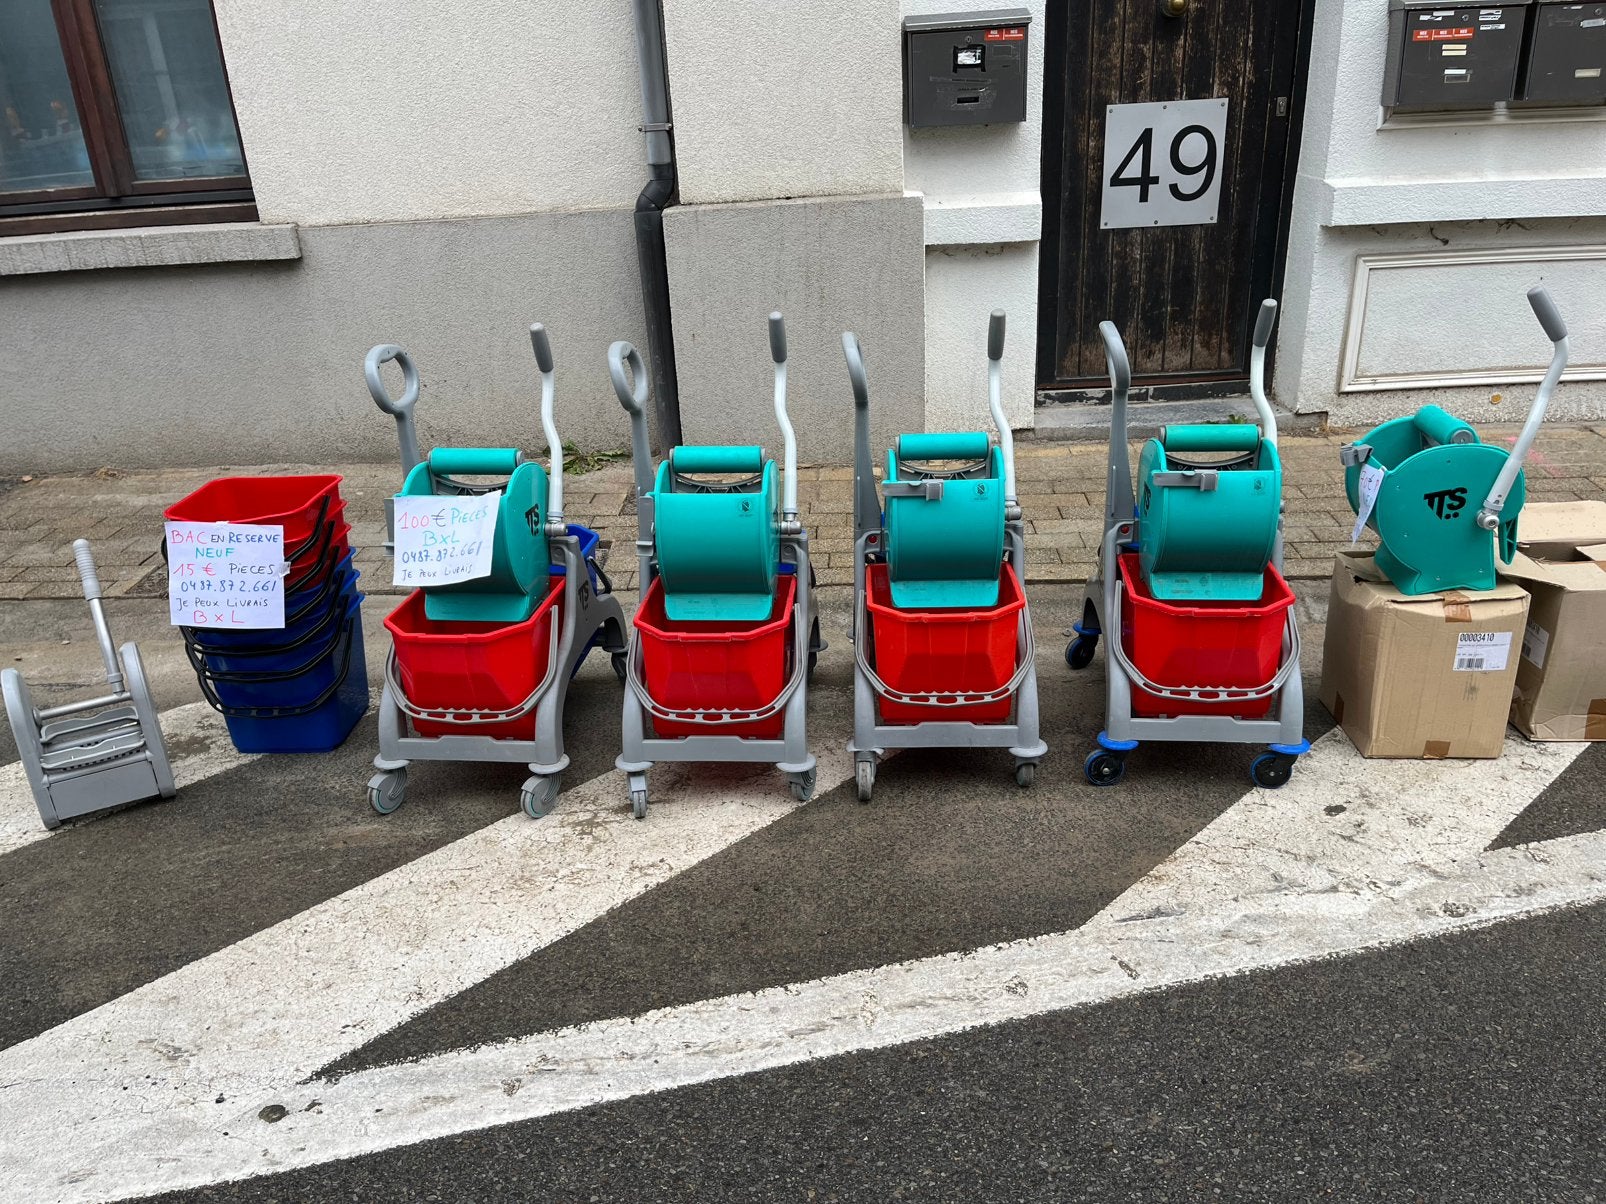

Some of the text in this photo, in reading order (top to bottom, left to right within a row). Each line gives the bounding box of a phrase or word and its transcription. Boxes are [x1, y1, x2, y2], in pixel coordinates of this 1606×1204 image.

[1109, 124, 1217, 203] 49
[1423, 487, 1468, 520] TTS
[171, 530, 280, 544] BAC EN RESERVE
[195, 547, 235, 559] NEUF
[176, 598, 188, 611] JE
[195, 597, 220, 607] PEUX
[1460, 633, 1495, 642] 00003410
